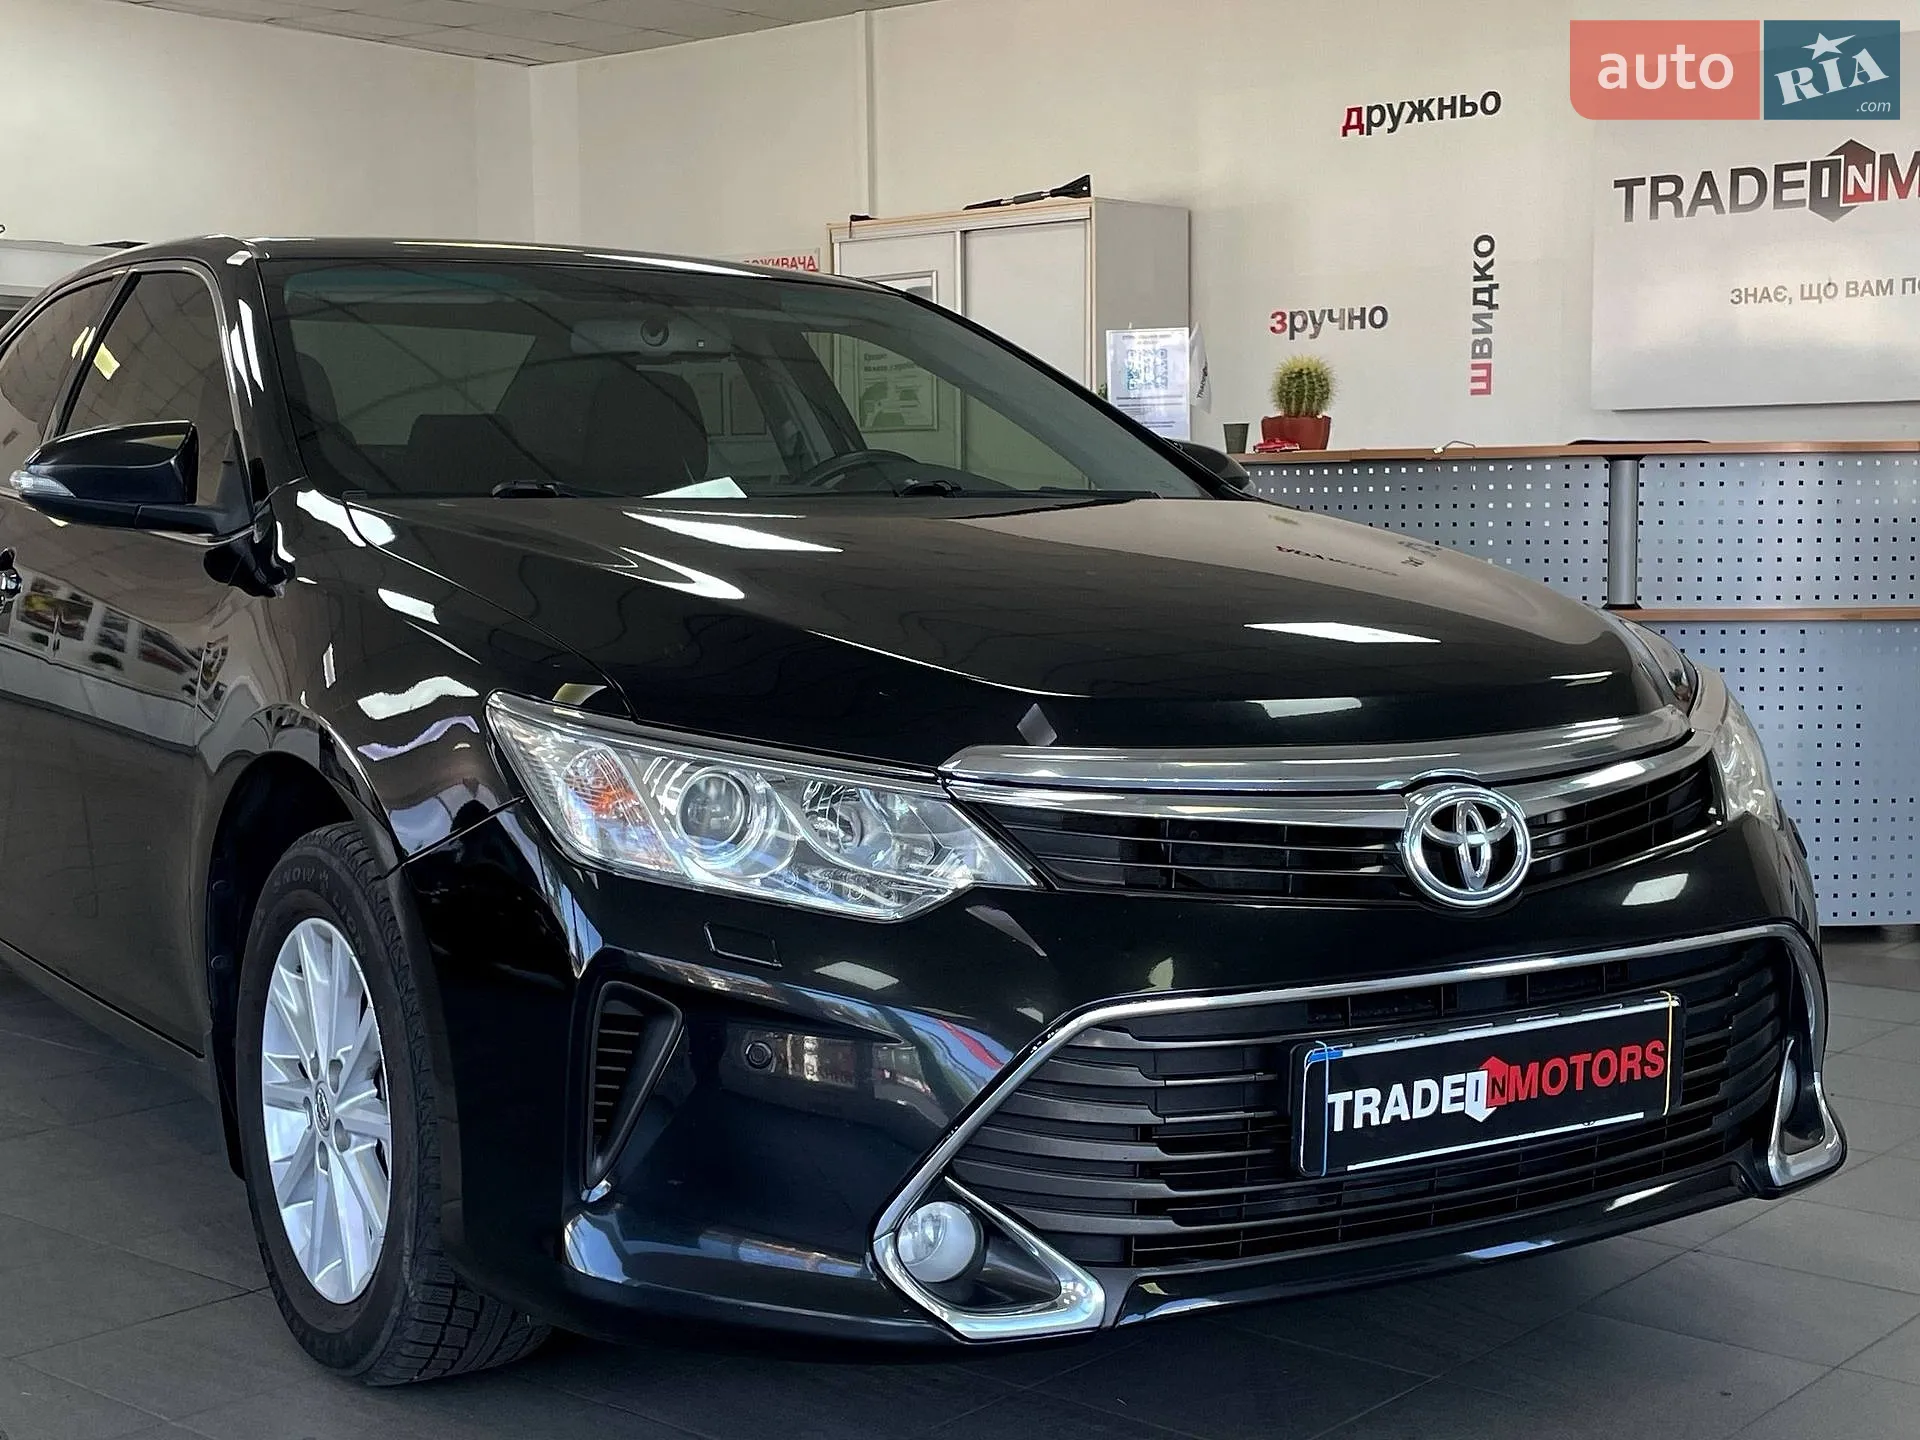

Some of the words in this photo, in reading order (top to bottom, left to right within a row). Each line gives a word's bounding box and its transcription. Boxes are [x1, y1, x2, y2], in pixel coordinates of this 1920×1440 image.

[1341, 90, 1502, 138] дружньо
[1729, 284, 1793, 306] ЗНАЄ,
[1799, 280, 1839, 305] ЩО
[1846, 278, 1894, 299] ВАМ
[1901, 276, 1920, 295] П
[1269, 305, 1389, 341] зручно
[1469, 234, 1500, 396] швидко
